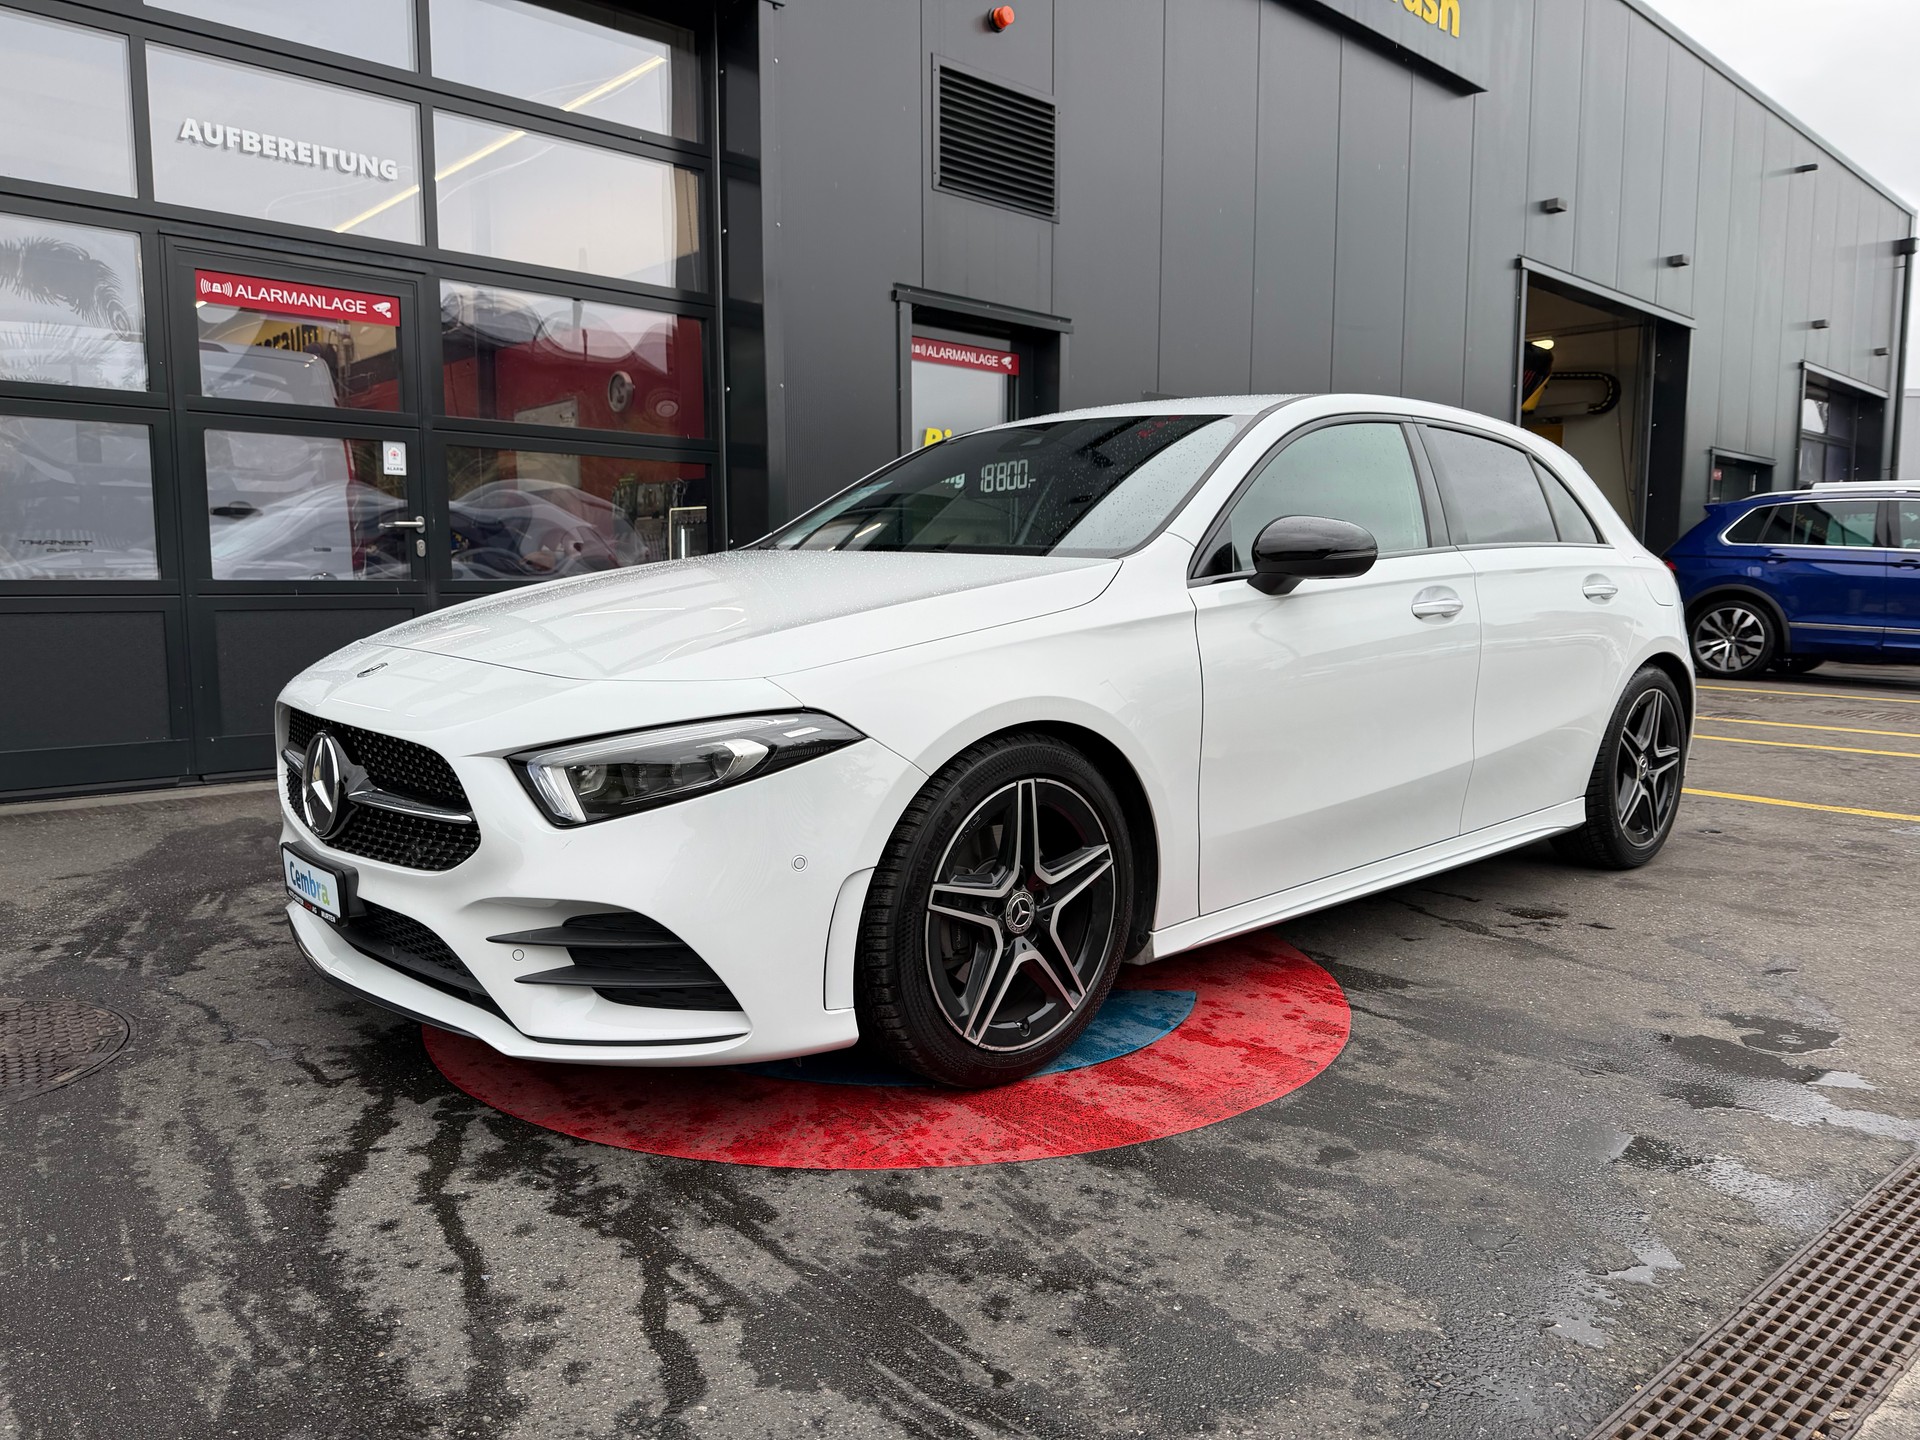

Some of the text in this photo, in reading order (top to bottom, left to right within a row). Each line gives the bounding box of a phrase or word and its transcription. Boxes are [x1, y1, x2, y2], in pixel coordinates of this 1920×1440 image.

[179, 118, 399, 182] AUFBEREITUNG
[234, 284, 367, 315] ALARMANLAGE
[926, 345, 999, 367] ALARMANLAGE
[289, 860, 330, 906] Cembra
